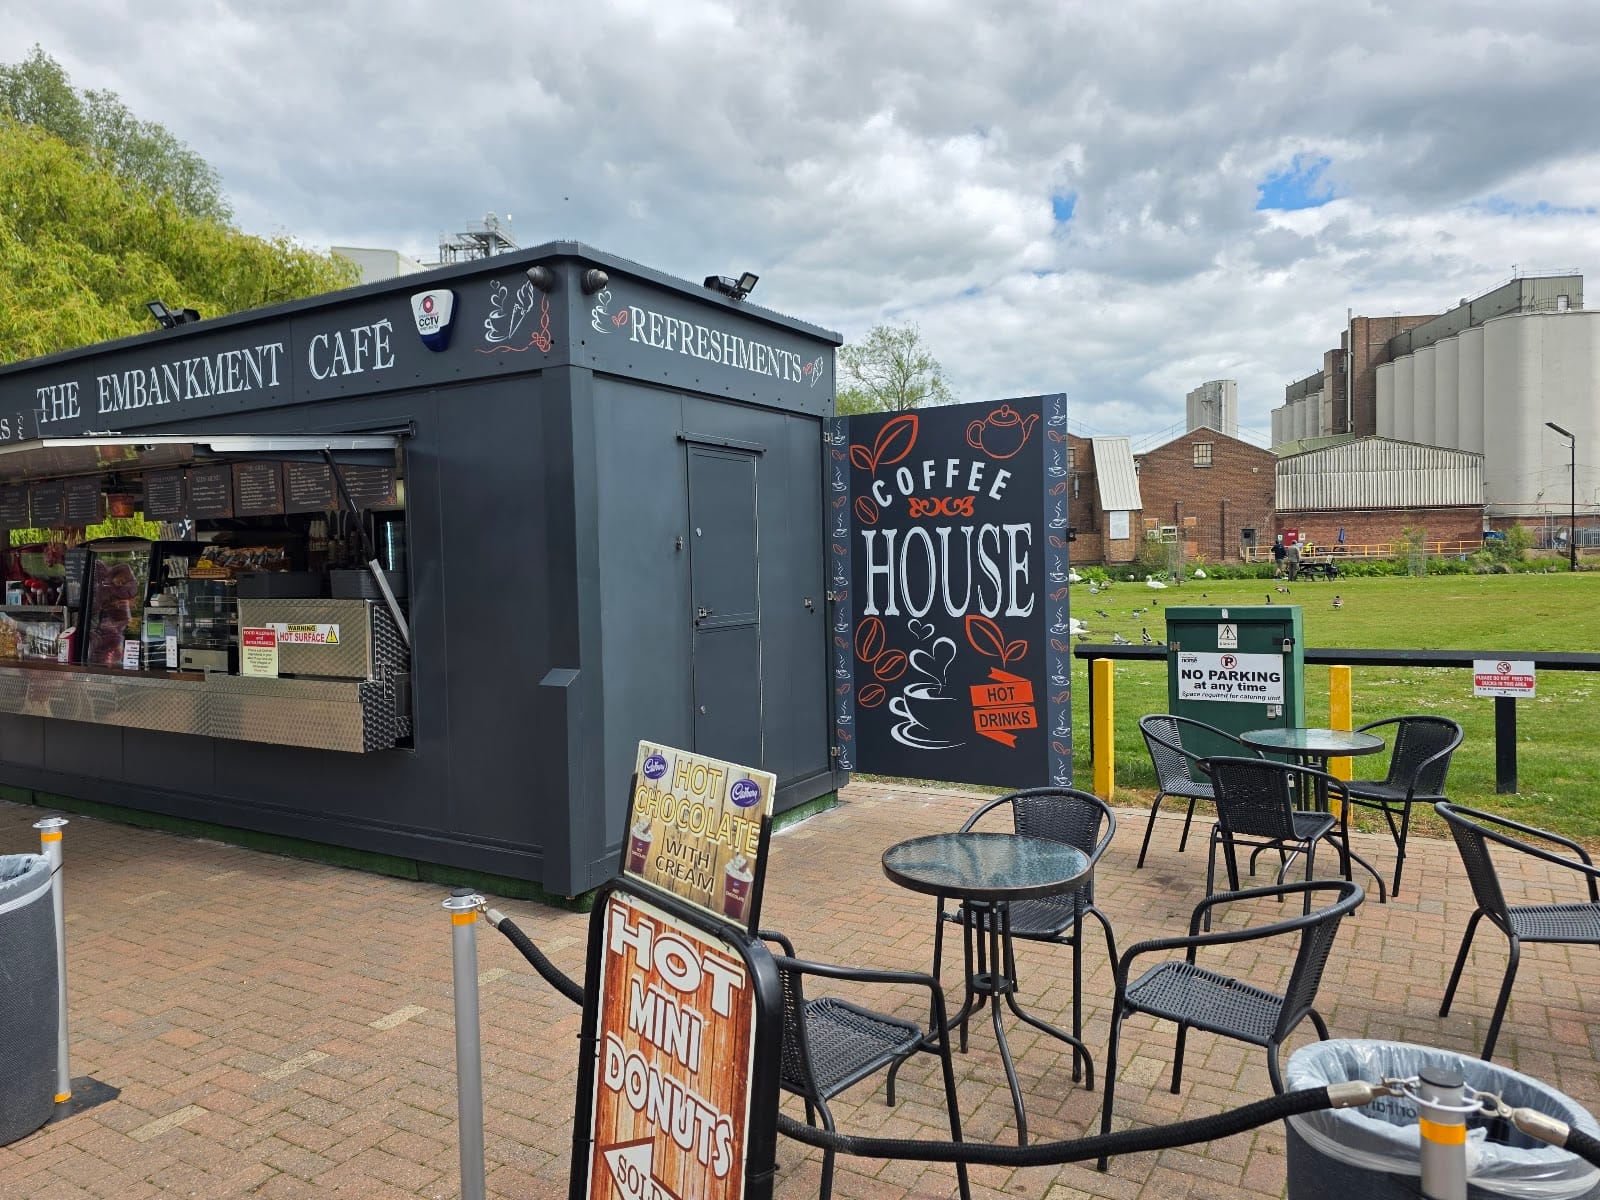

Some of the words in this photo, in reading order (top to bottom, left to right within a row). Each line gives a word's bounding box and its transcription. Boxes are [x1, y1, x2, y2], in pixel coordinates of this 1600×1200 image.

[418, 316, 440, 327] CCTV
[628, 305, 802, 384] REFRESHMENTS
[36, 381, 81, 423] THE
[97, 342, 284, 414] EMBANKMENT
[308, 317, 395, 380] CAFÉ
[871, 458, 1012, 507] COFFEE
[861, 523, 1035, 618] HOUSE
[279, 632, 294, 642] HOT
[295, 633, 325, 643] SURFACE
[986, 686, 1015, 704] HOT
[1181, 669, 1204, 680] NO
[1208, 670, 1281, 683] PARKING
[1193, 681, 1207, 690] at
[1210, 683, 1233, 693] any
[1237, 682, 1267, 692] time
[979, 711, 1031, 728] DRINKS
[675, 760, 722, 799] HOT
[732, 783, 758, 800] Cadbury
[634, 785, 761, 856] CHOCOLATE
[666, 838, 710, 869] WITH
[656, 855, 715, 893] CREAM
[609, 904, 746, 1019] HOT
[629, 974, 705, 1074] MINI
[604, 1031, 735, 1179] DONUTS
